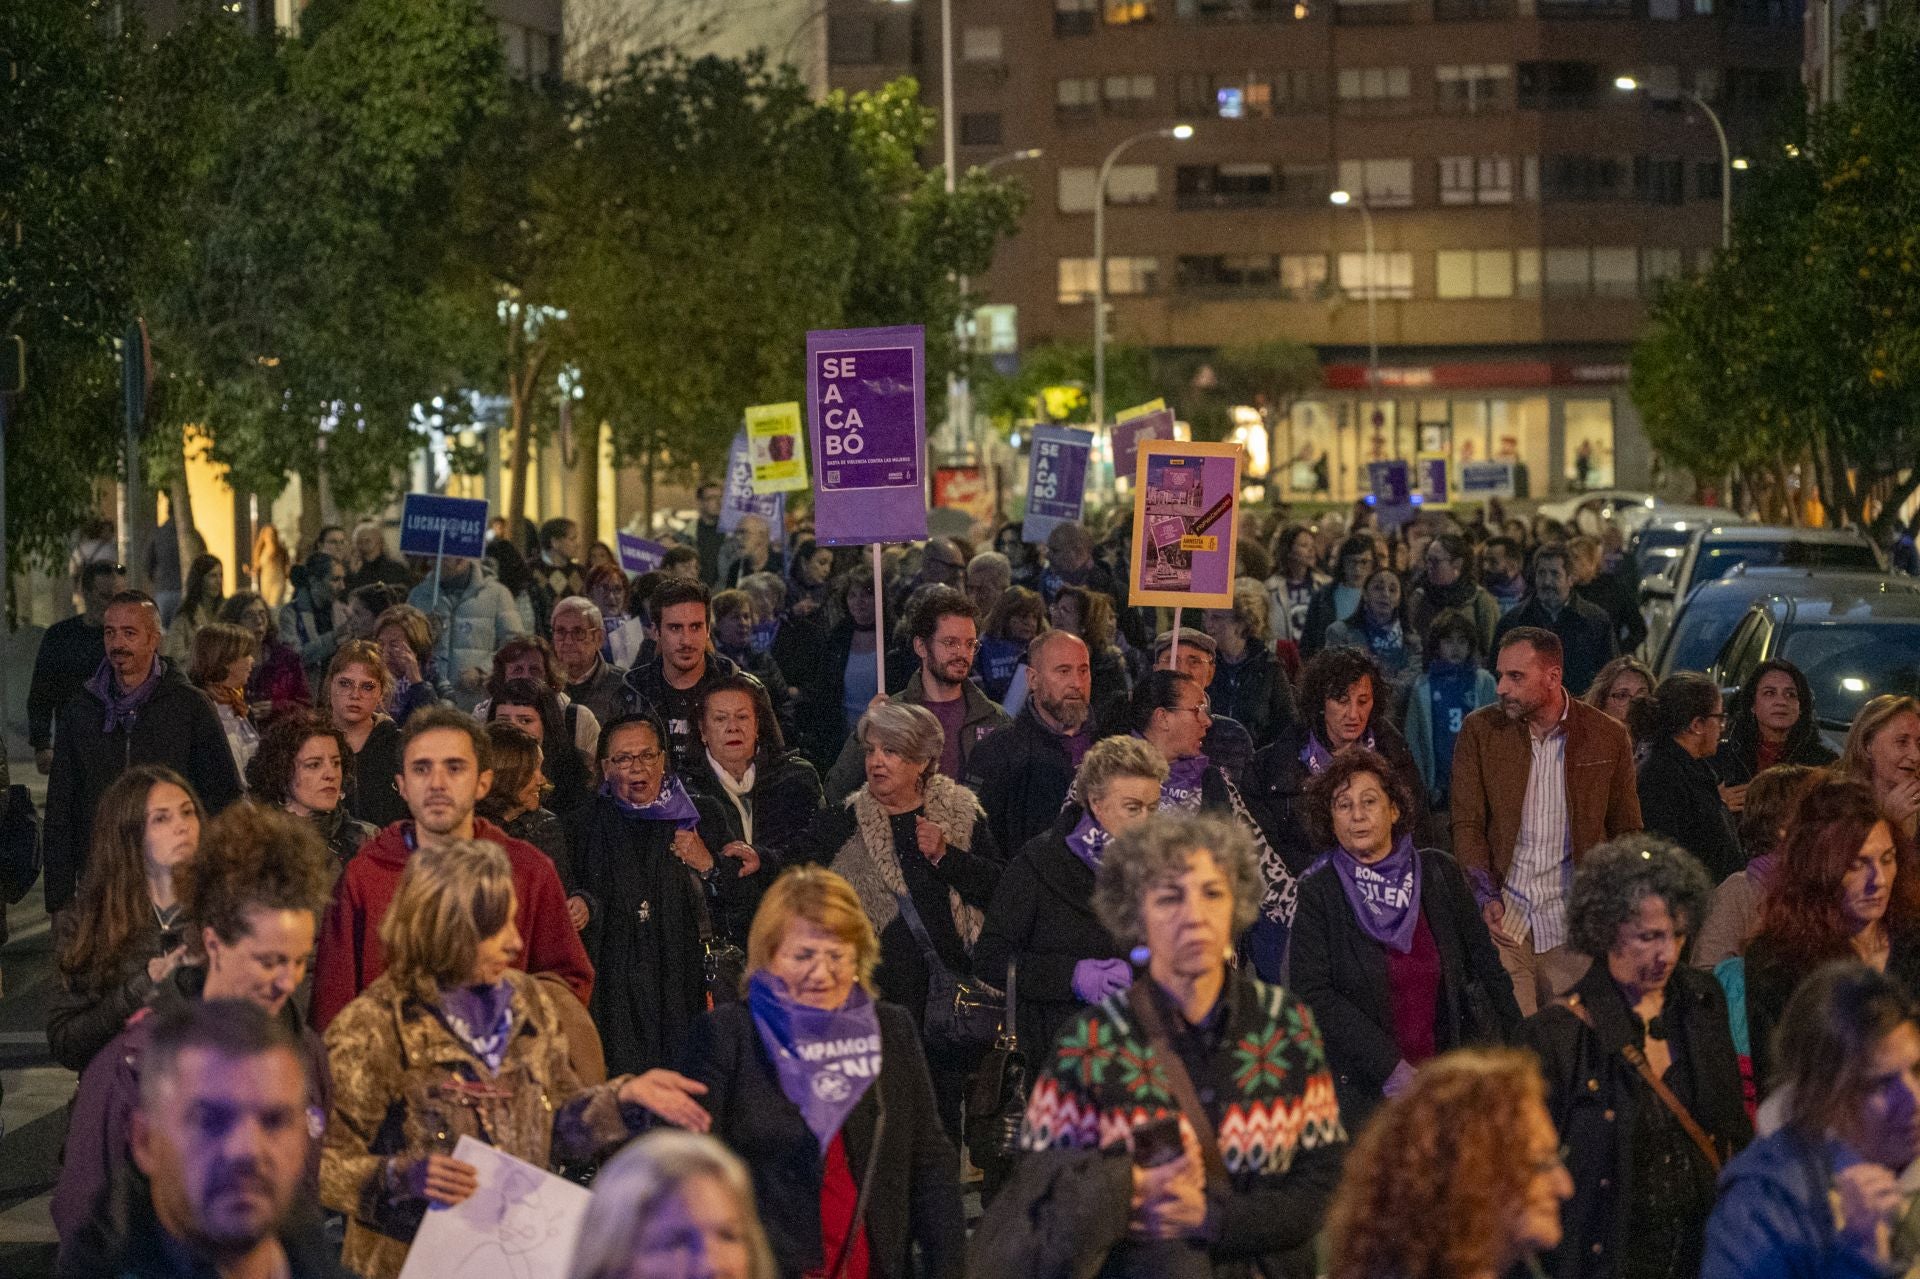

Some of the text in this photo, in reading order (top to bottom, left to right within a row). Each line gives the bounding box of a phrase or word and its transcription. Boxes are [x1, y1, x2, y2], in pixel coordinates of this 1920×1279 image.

[823, 357, 856, 379] SE
[824, 384, 843, 404] A
[825, 408, 864, 430] CA
[826, 428, 864, 455] BÓ
[1040, 443, 1059, 457] SE
[1038, 457, 1049, 470] A
[1037, 470, 1057, 486] CA
